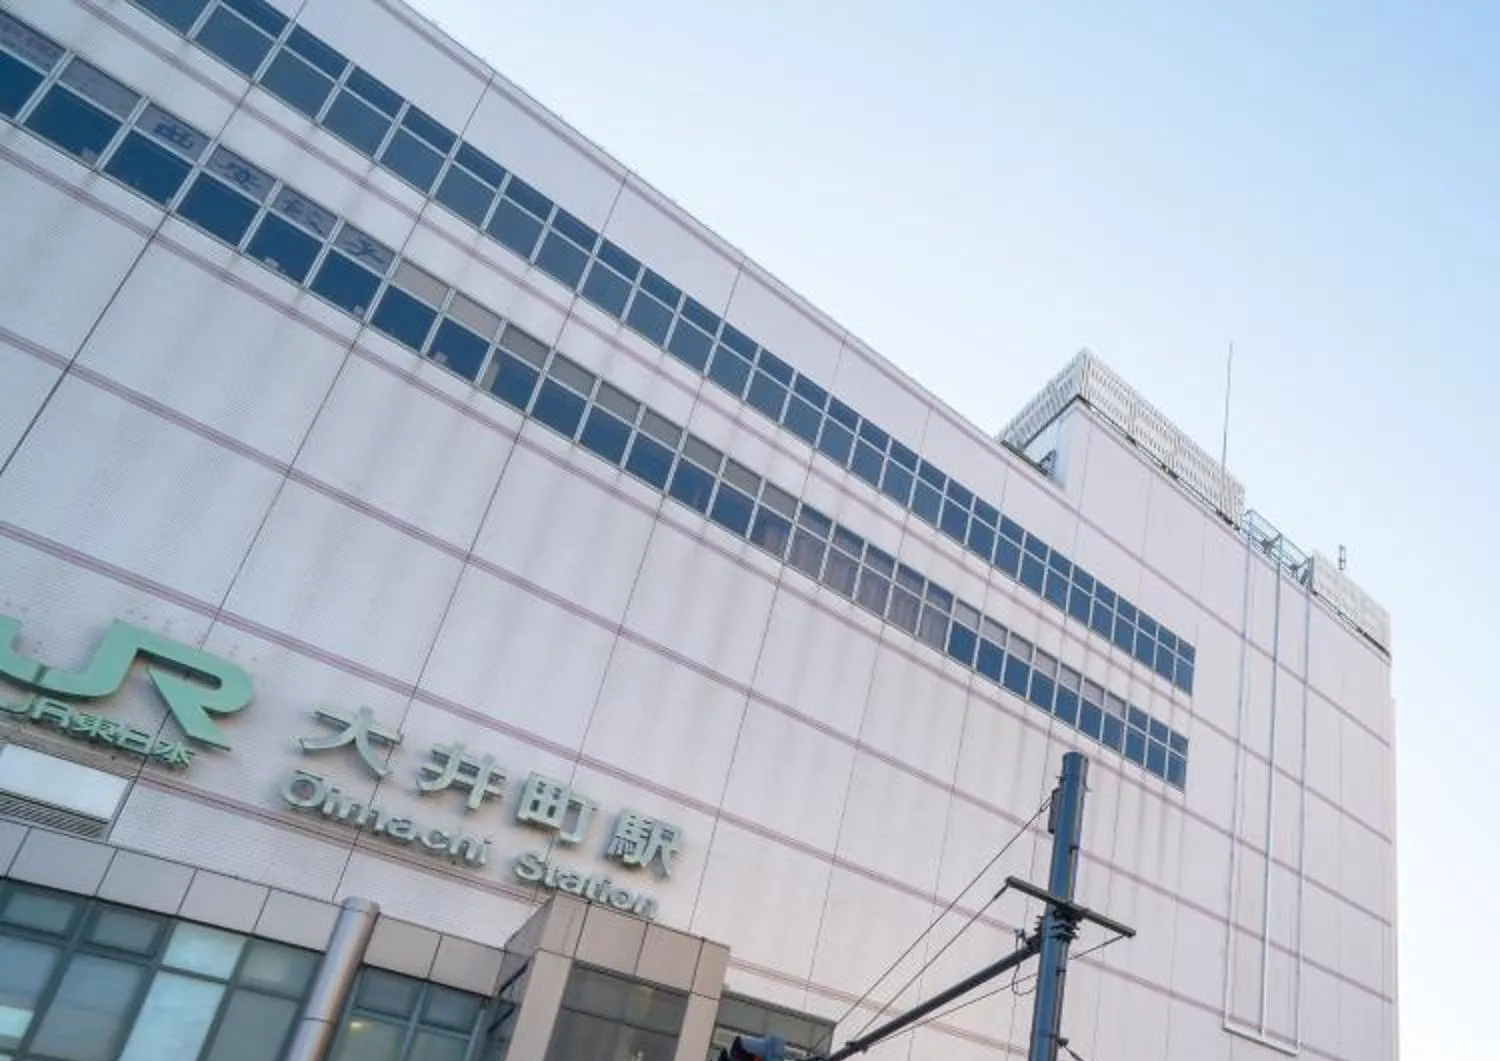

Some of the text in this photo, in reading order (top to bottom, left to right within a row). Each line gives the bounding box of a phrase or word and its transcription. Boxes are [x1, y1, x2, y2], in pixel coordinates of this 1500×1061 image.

[0, 613, 254, 752] JR
[281, 768, 660, 917] Oimachi Station
[298, 703, 684, 878] 大井町駅
